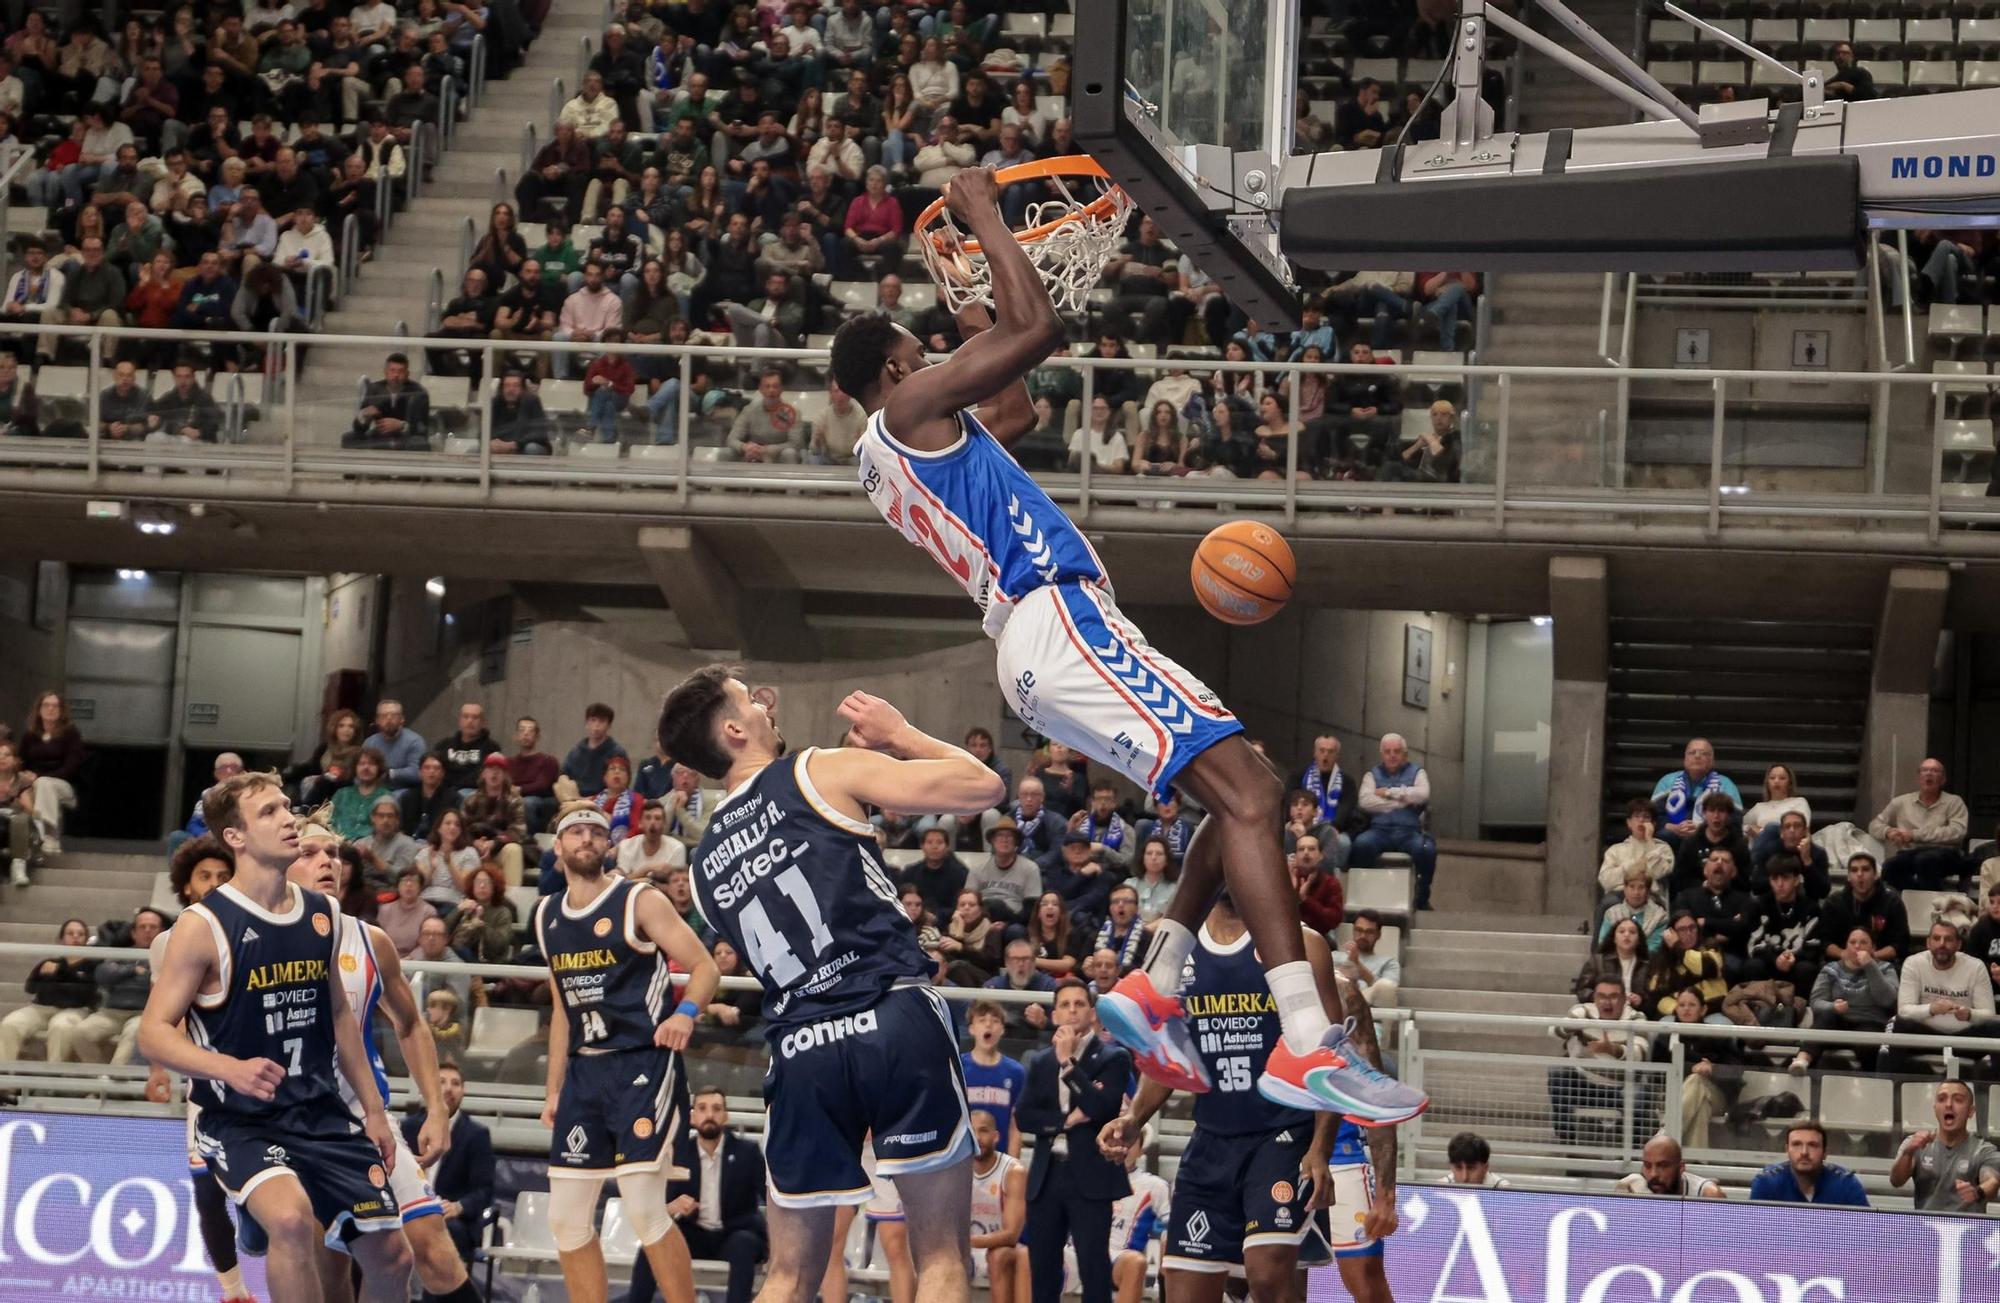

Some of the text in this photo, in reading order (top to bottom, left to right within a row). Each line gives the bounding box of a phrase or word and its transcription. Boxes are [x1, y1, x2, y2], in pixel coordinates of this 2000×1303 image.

[701, 812, 769, 881] COSIALLS
[738, 863, 835, 989] 41
[817, 949, 861, 982] RURAL
[1210, 1016, 1257, 1031] OVIEDO
[1223, 1031, 1263, 1043] Asturias
[282, 1037, 303, 1077] 7
[1215, 1055, 1251, 1093] 35
